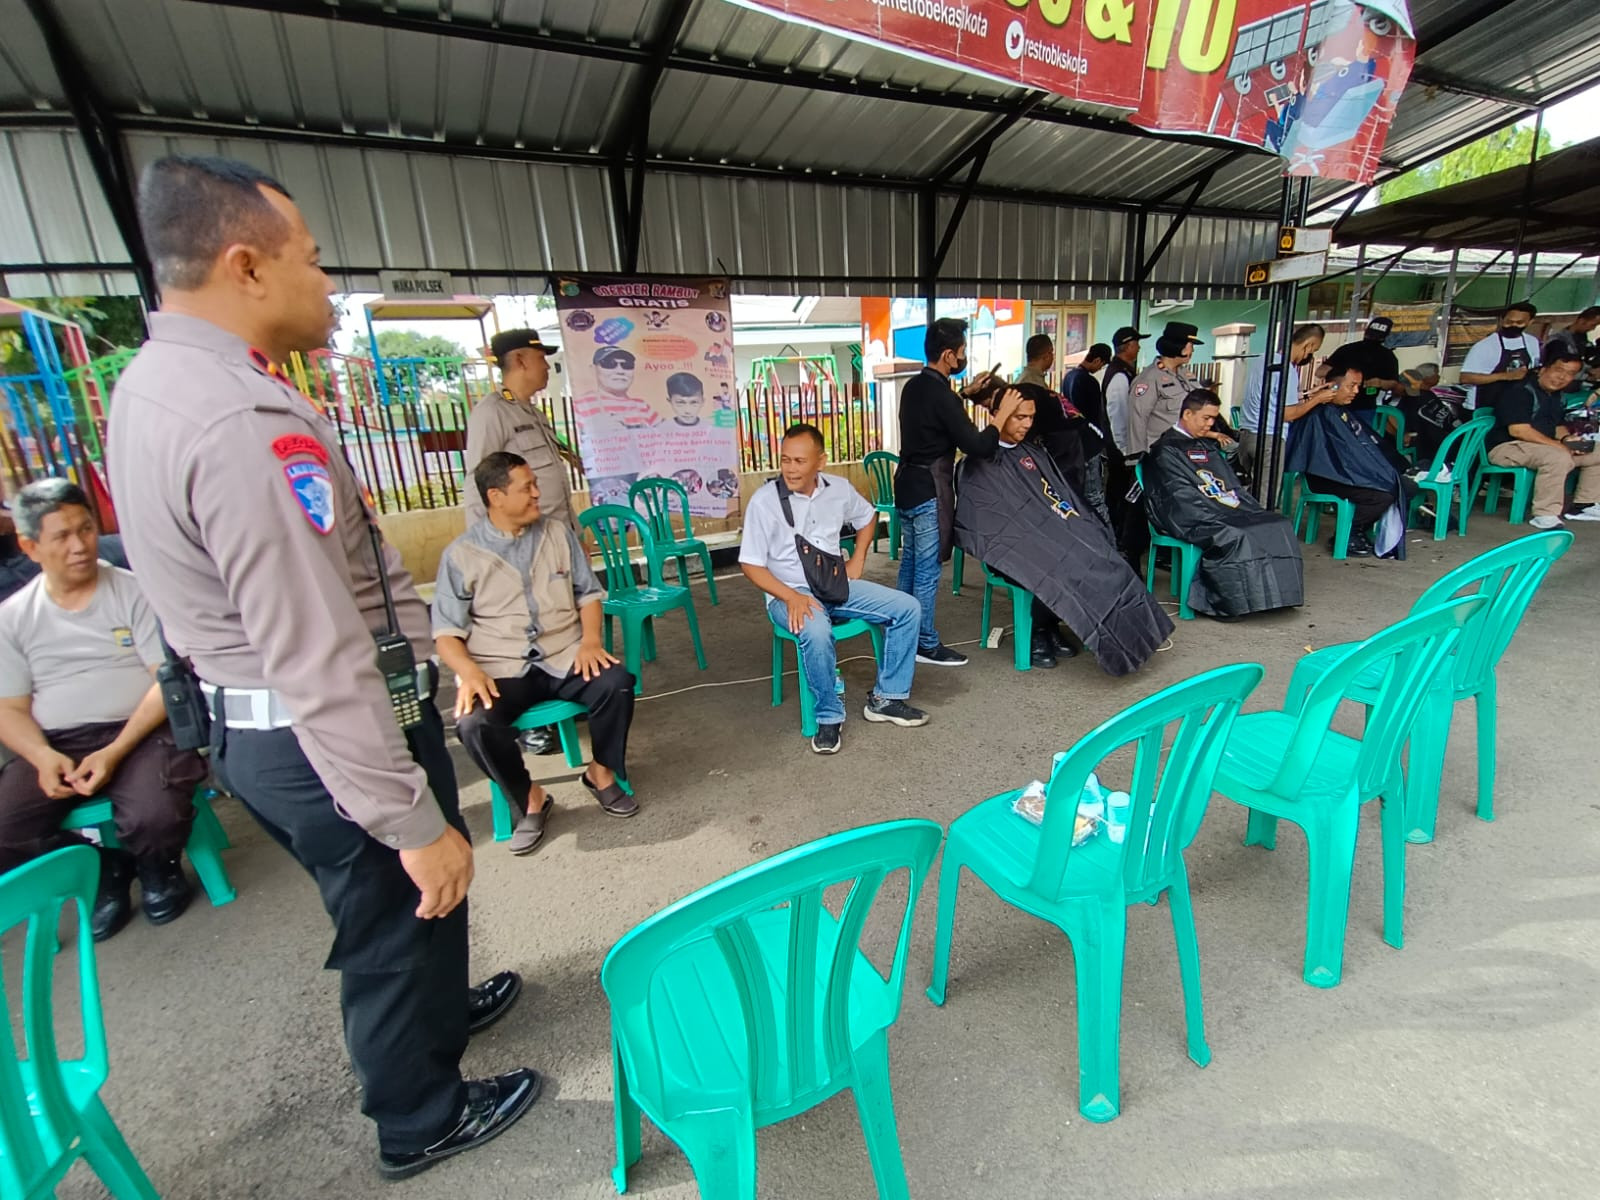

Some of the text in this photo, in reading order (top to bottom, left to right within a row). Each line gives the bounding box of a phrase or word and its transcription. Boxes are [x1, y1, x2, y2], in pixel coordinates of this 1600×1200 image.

[866, 0, 989, 37] metrobekasikota
[1024, 38, 1088, 75] restrobkskota
[651, 283, 700, 299] RAMBUT
[618, 297, 690, 308] GRATIS
[1370, 322, 1388, 332] POLICE
